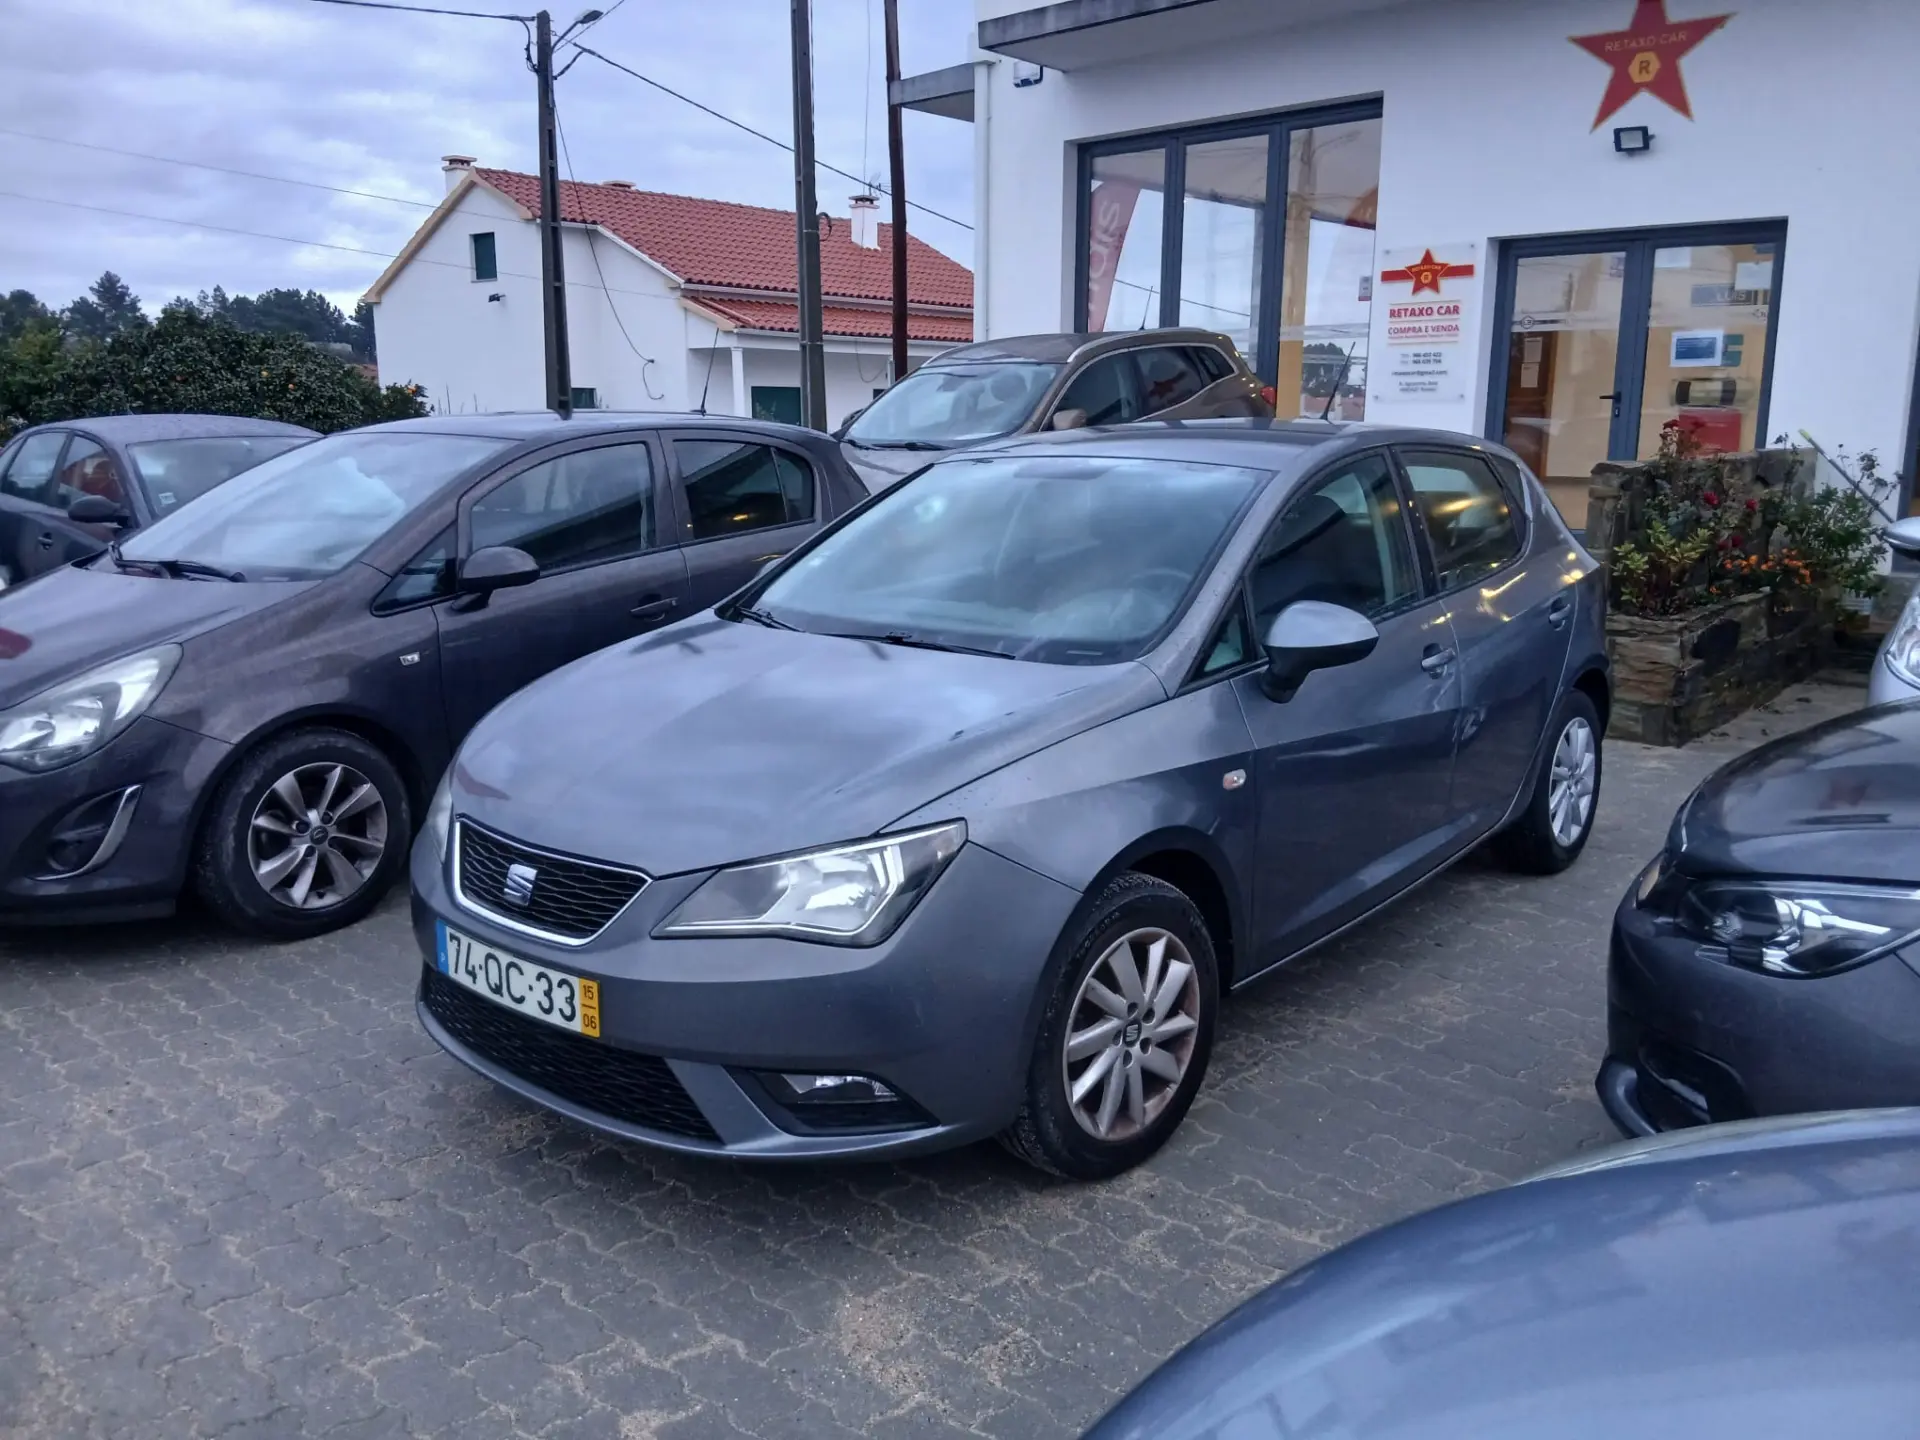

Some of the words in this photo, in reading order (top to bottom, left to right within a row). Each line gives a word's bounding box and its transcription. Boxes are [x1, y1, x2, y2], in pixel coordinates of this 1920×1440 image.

[1604, 35, 1656, 53] RETAXO
[1659, 30, 1688, 46] CAR
[1638, 59, 1651, 76] R
[1389, 307, 1433, 318] RETAXO
[1436, 304, 1459, 315] CAR
[1388, 325, 1423, 335] COMPRA
[1424, 325, 1430, 333] E
[1430, 324, 1460, 332] VENDA
[582, 984, 594, 1000] 15
[582, 1013, 597, 1030] 06
